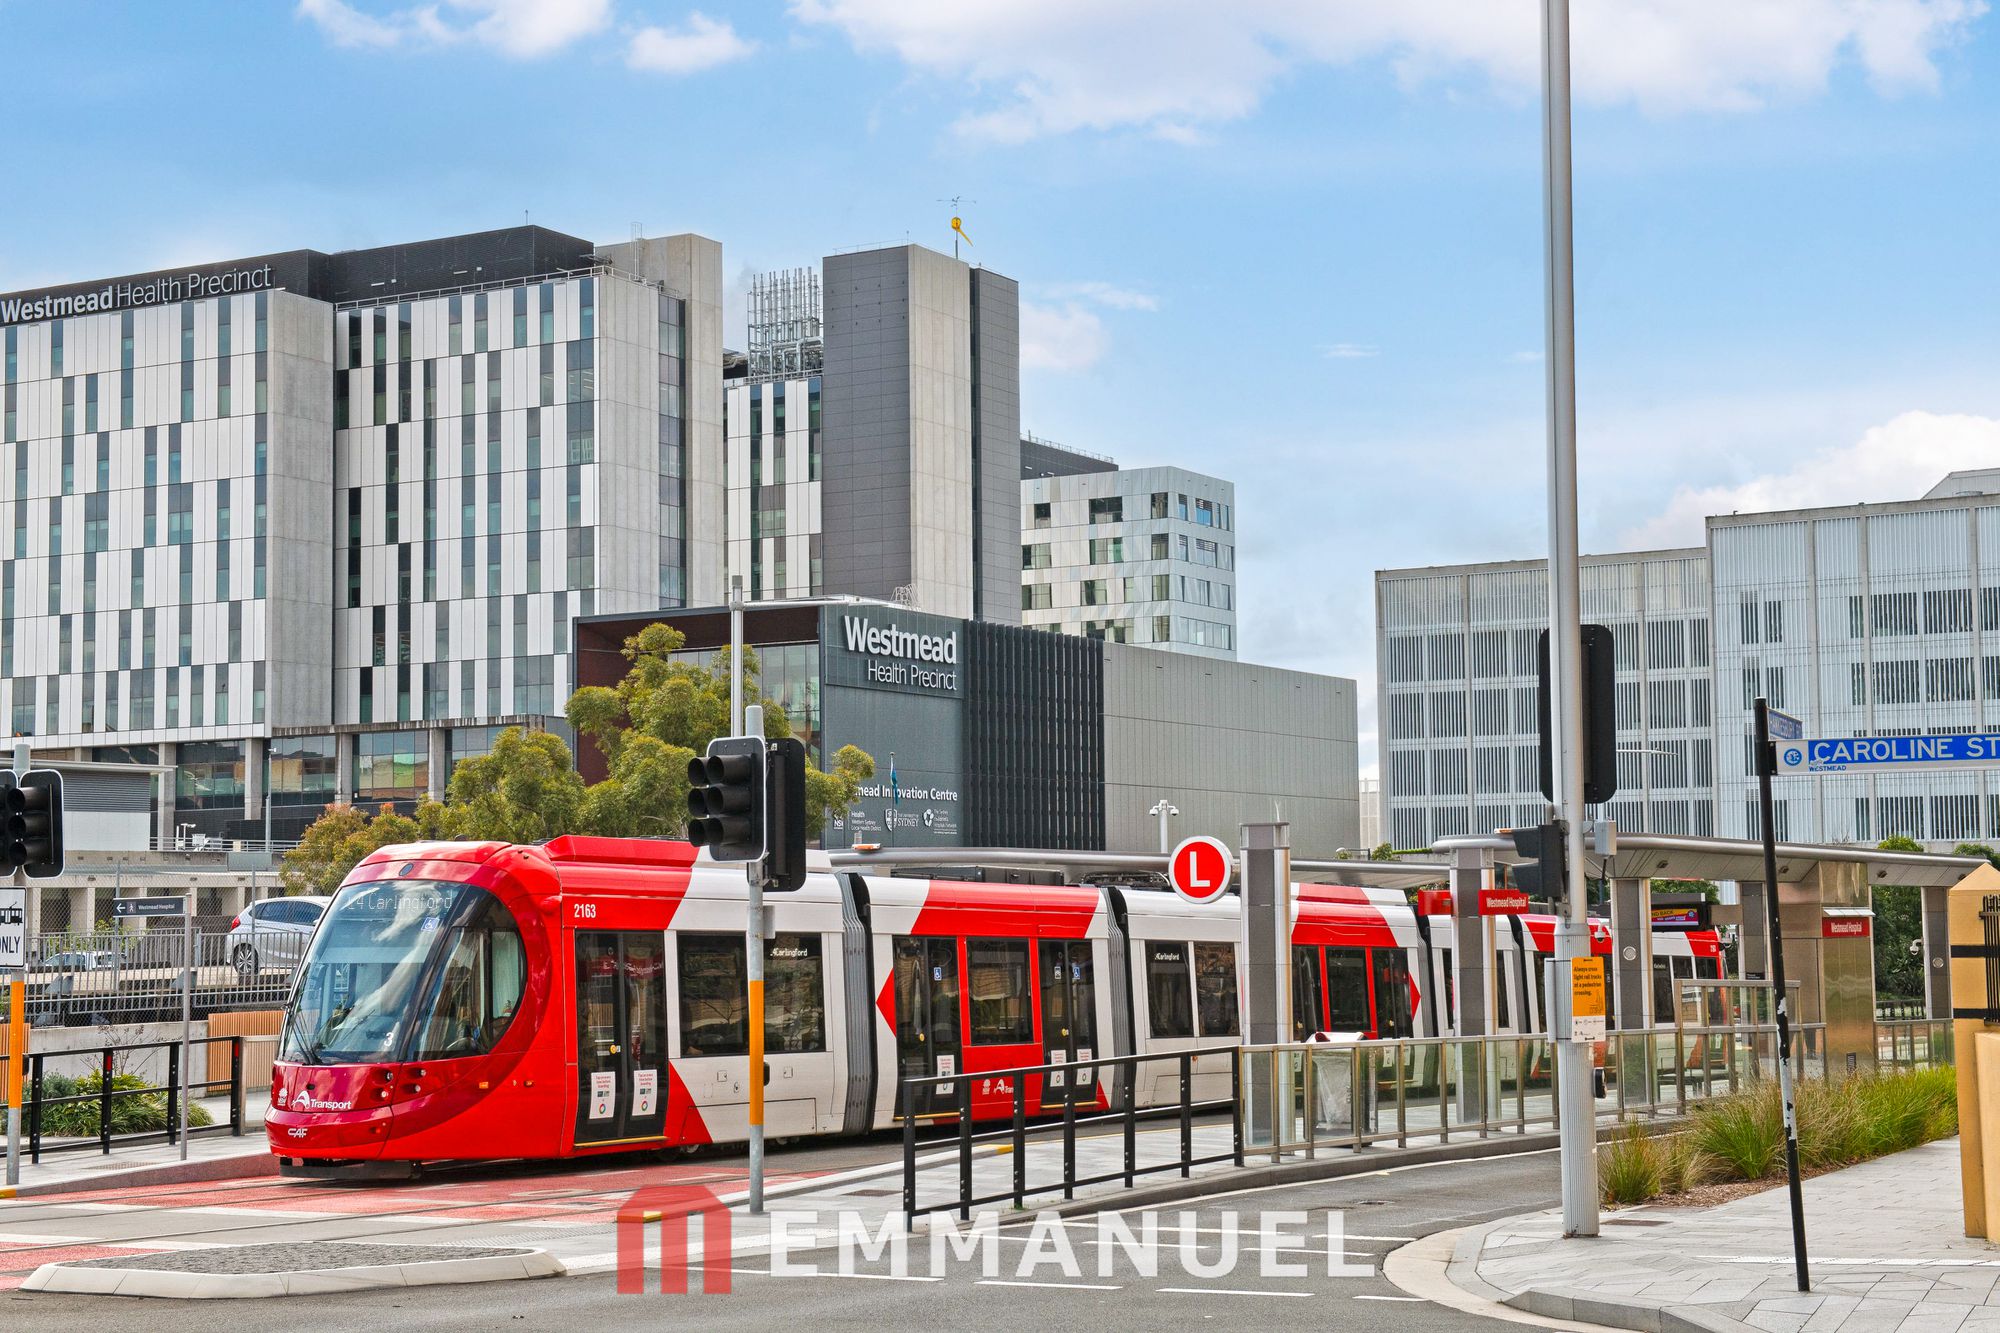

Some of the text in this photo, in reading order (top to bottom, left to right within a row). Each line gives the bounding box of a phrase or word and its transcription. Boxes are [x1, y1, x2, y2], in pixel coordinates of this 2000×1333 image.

[1, 263, 272, 324] Westmead Health Precinct
[844, 615, 957, 664] Westmead
[868, 659, 957, 691] Health Precinct
[1814, 736, 2000, 762] CAROLINE ST
[855, 784, 958, 801] mead Inovation Centre
[851, 810, 865, 818] Health
[898, 818, 919, 827] SYDNEY
[1190, 851, 1210, 887] L
[368, 889, 453, 911] Carlingford
[1486, 896, 1527, 910] Westmead Hospital
[574, 903, 596, 918] 2163
[0, 936, 20, 953] NLY
[384, 1031, 394, 1047] 3
[310, 1099, 351, 1111] Transport
[288, 1128, 308, 1139] CAF
